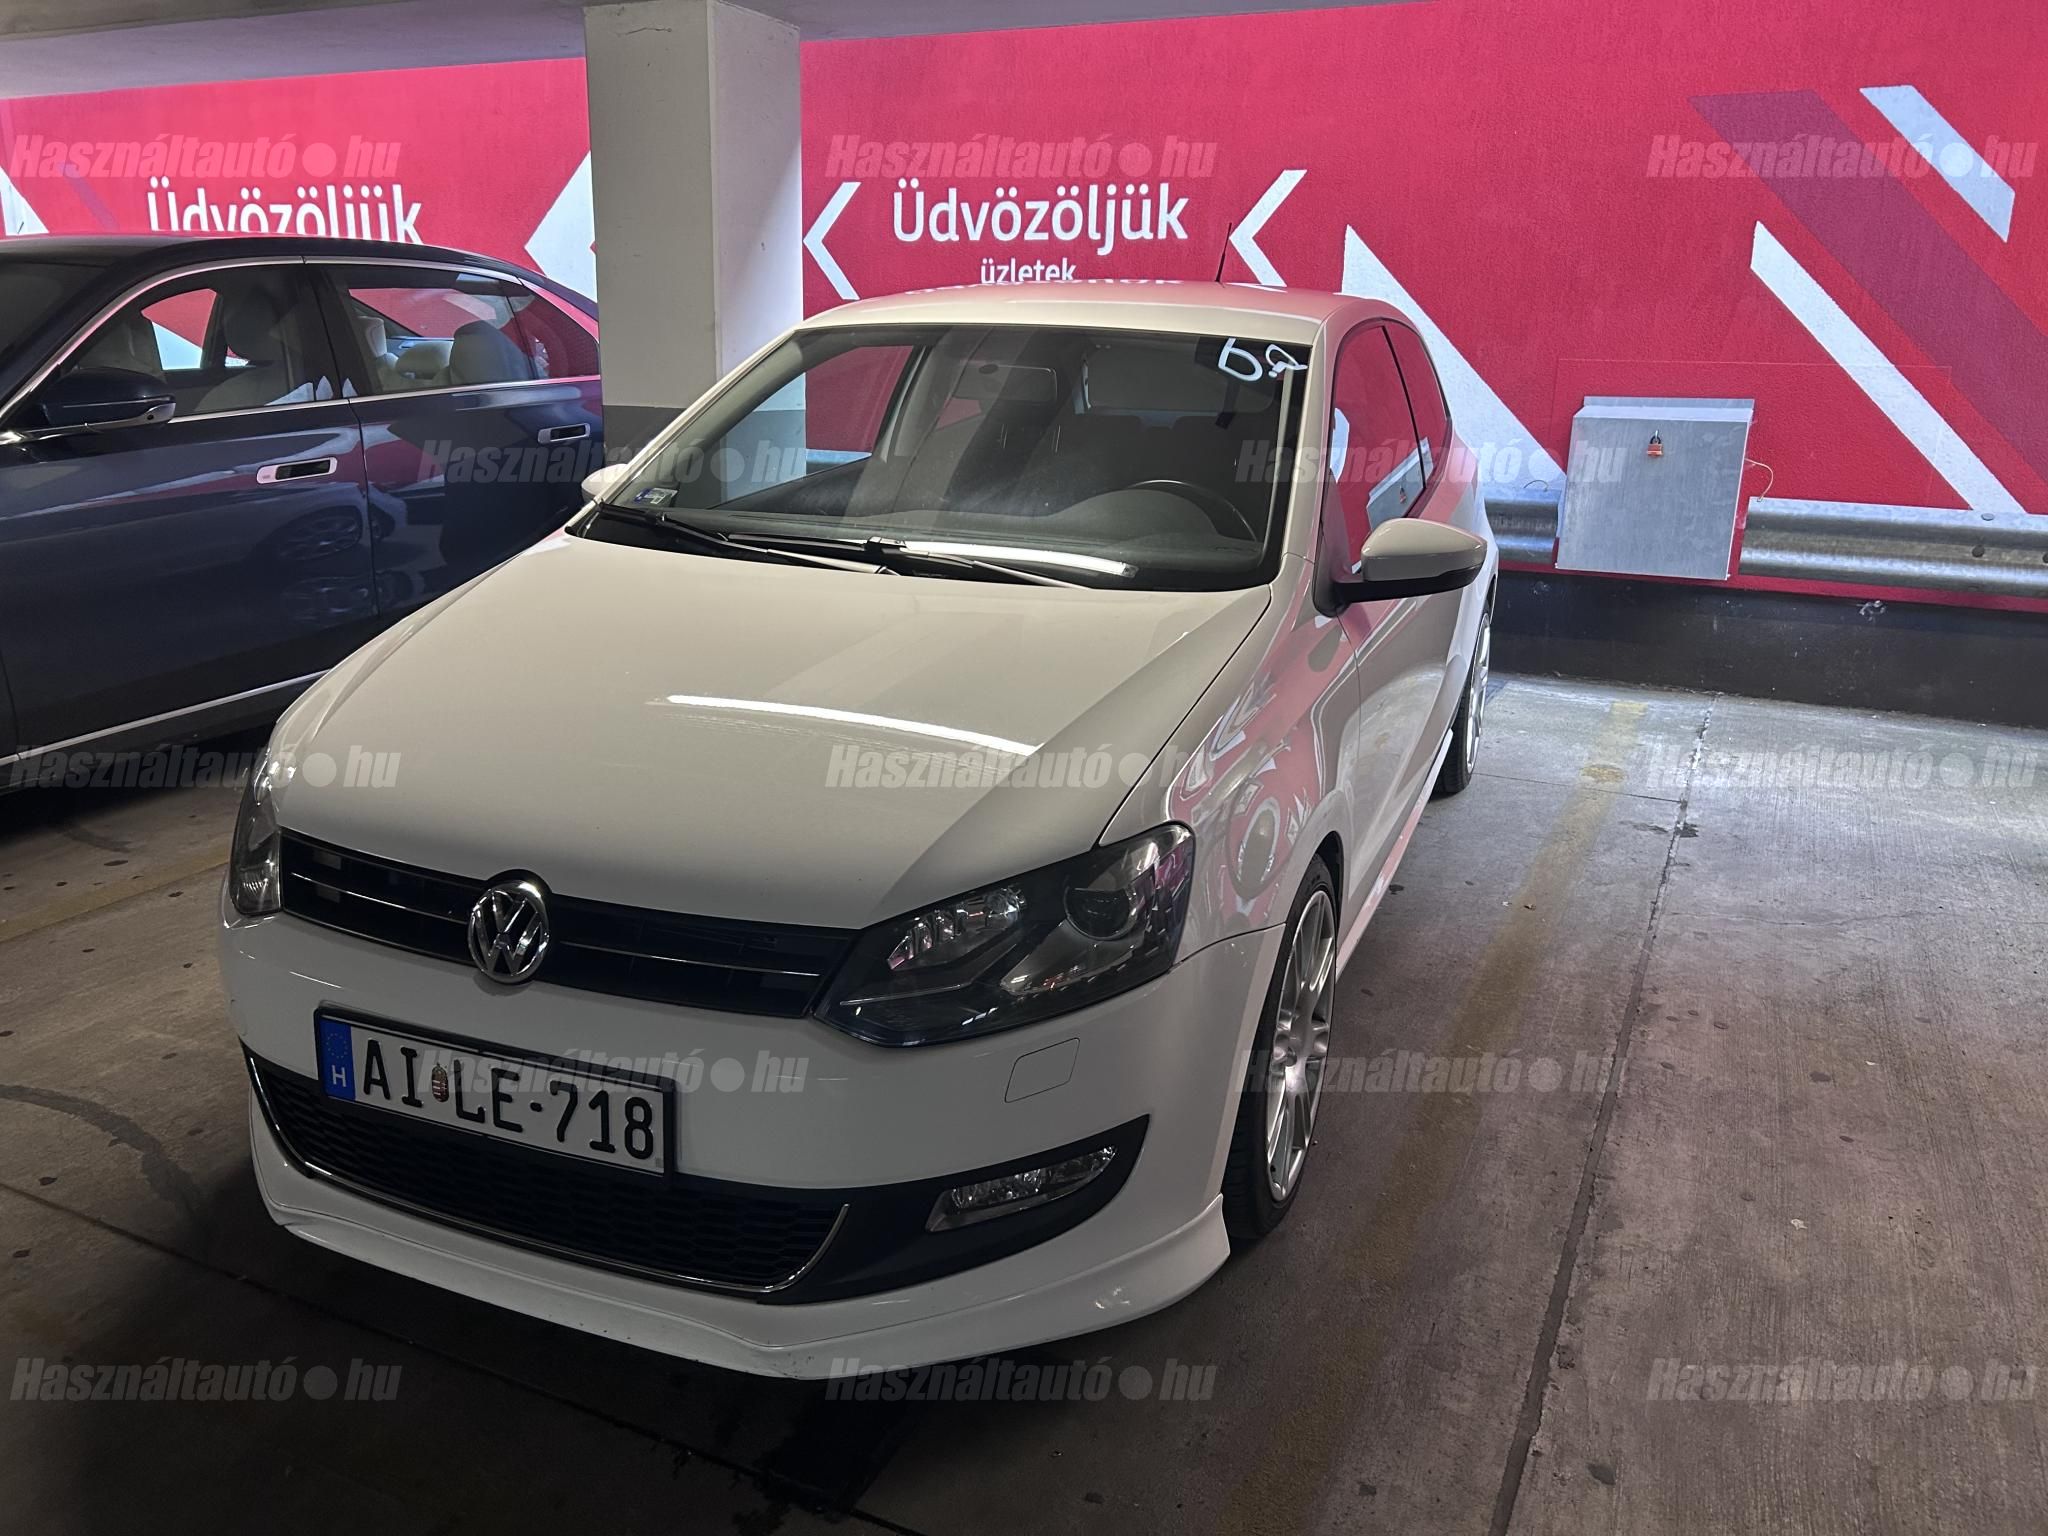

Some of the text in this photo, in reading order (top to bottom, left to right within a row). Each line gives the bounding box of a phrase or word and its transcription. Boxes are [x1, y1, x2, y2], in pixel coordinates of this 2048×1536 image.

[893, 177, 1189, 256] Üdvözöljük
[980, 257, 1077, 284] üzletek
[330, 1065, 346, 1088] H
